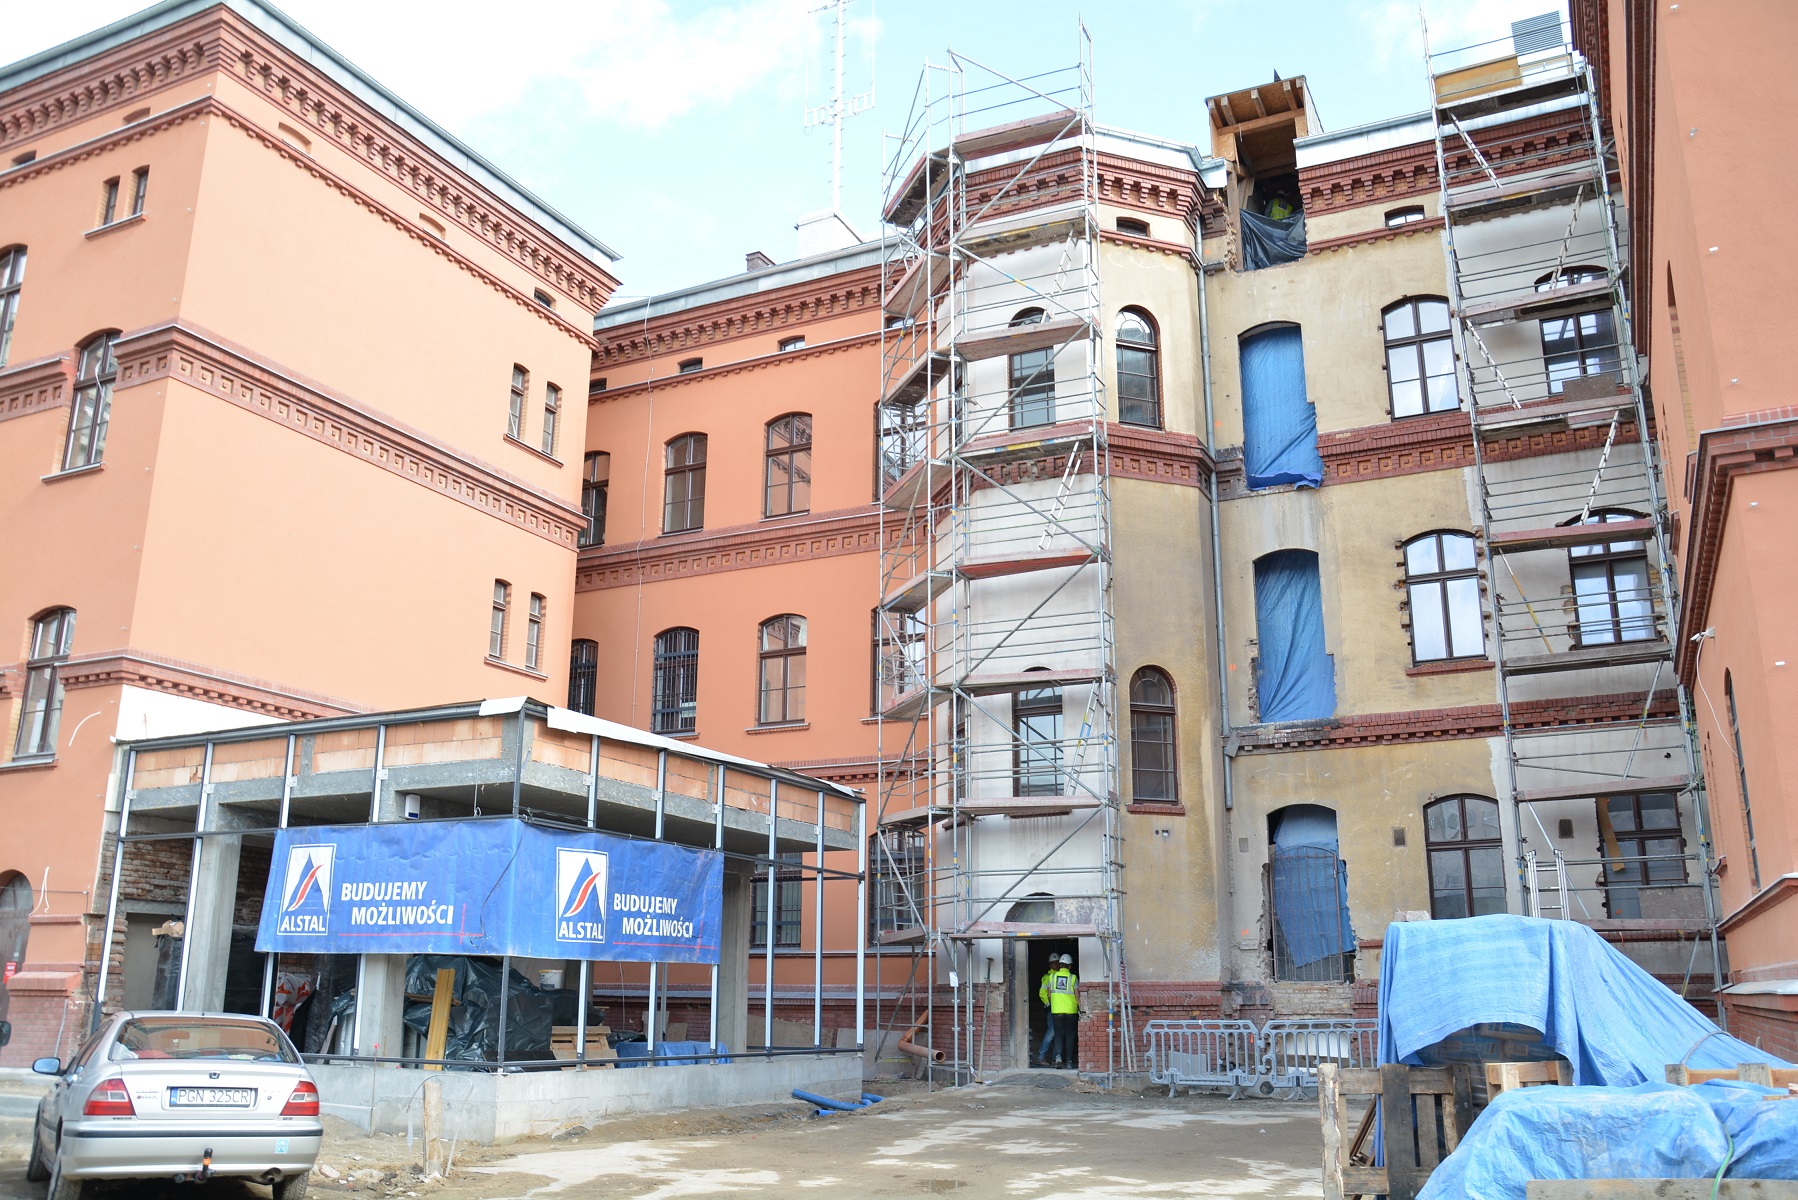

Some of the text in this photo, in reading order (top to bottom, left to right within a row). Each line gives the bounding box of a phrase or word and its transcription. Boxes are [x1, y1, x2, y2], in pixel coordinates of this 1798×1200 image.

[341, 881, 428, 901] BUDUJEMY
[351, 899, 455, 925] MOŻLIWOŚCI
[613, 893, 678, 915] BUDUJEMY
[280, 915, 326, 932] ALSTAL
[558, 920, 604, 940] ALSTAL
[622, 914, 693, 938] MOŻLIWOŚCI
[178, 1089, 249, 1103] PGN 325CR
